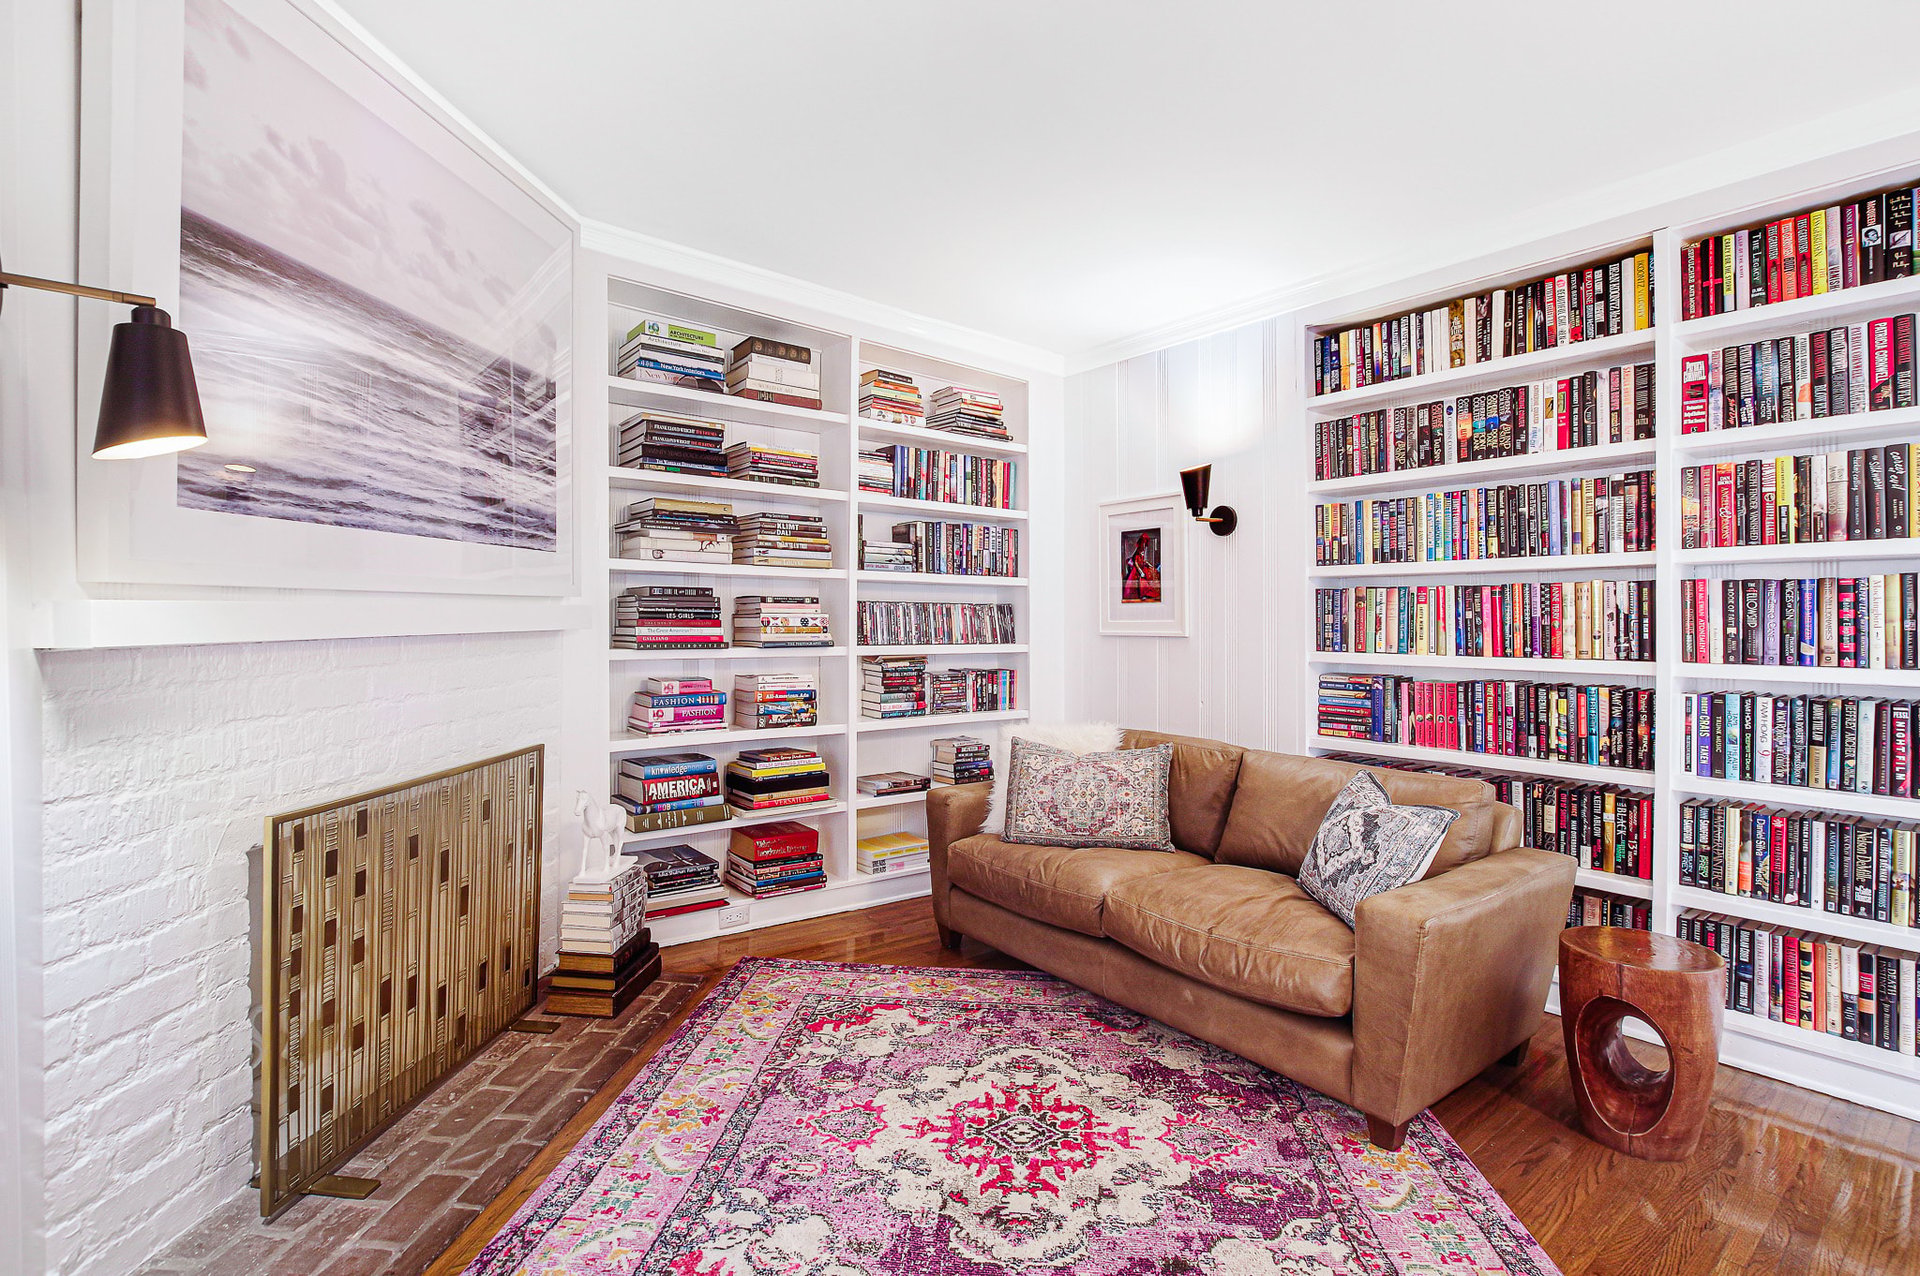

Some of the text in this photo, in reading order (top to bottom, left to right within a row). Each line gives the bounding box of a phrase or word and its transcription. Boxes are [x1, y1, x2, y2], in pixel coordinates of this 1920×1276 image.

[1724, 238, 1732, 254] CRAZY
[1752, 252, 1762, 280] LEGACY
[1784, 257, 1794, 272] BODY
[1830, 266, 1840, 290] VANISH
[1609, 263, 1620, 310] DEAN KOONTZ
[1874, 322, 1888, 384] PATRICIA CORNWELL
[1748, 466, 1759, 540] JOSEPH FINDER VANISHED
[1552, 587, 1560, 619] ANNE PERRY
[1746, 592, 1758, 628] FELLOWSHIP
[1786, 580, 1795, 620] WAGES SIN
[1871, 580, 1882, 628] Mockingbird
[1825, 596, 1833, 640] MILLIONAIRES
[1842, 622, 1851, 648] Elephants
[654, 697, 694, 706] FASHION
[682, 708, 716, 717] FASHION
[1538, 688, 1546, 722] ADRENALINE
[1612, 692, 1622, 718] AMY TAN
[1640, 694, 1648, 713] Daniel
[1744, 698, 1752, 730] TAMI HOAG
[1812, 704, 1824, 720] ABOVE
[1760, 702, 1768, 743] TAMI HOAG
[1812, 732, 1824, 742] LAW
[1844, 704, 1856, 758] JEFFREY ARCHER
[1700, 716, 1710, 764] CRAIS TAKEN
[1896, 722, 1906, 780] NIGHT FILM
[649, 778, 706, 796] AMERICA
[1594, 796, 1602, 837] KEITH ABLOW
[1617, 808, 1627, 835] BLACK
[1756, 818, 1766, 885] Daniel Silva Heist
[1856, 831, 1872, 882] Nelson DeMille
[1880, 838, 1888, 858] ALLISON
[1772, 938, 1780, 958] DICK
[1786, 946, 1796, 974] ACCIDENT
[1878, 960, 1886, 994] INSTINCT
[1888, 969, 1896, 996] DEATH
